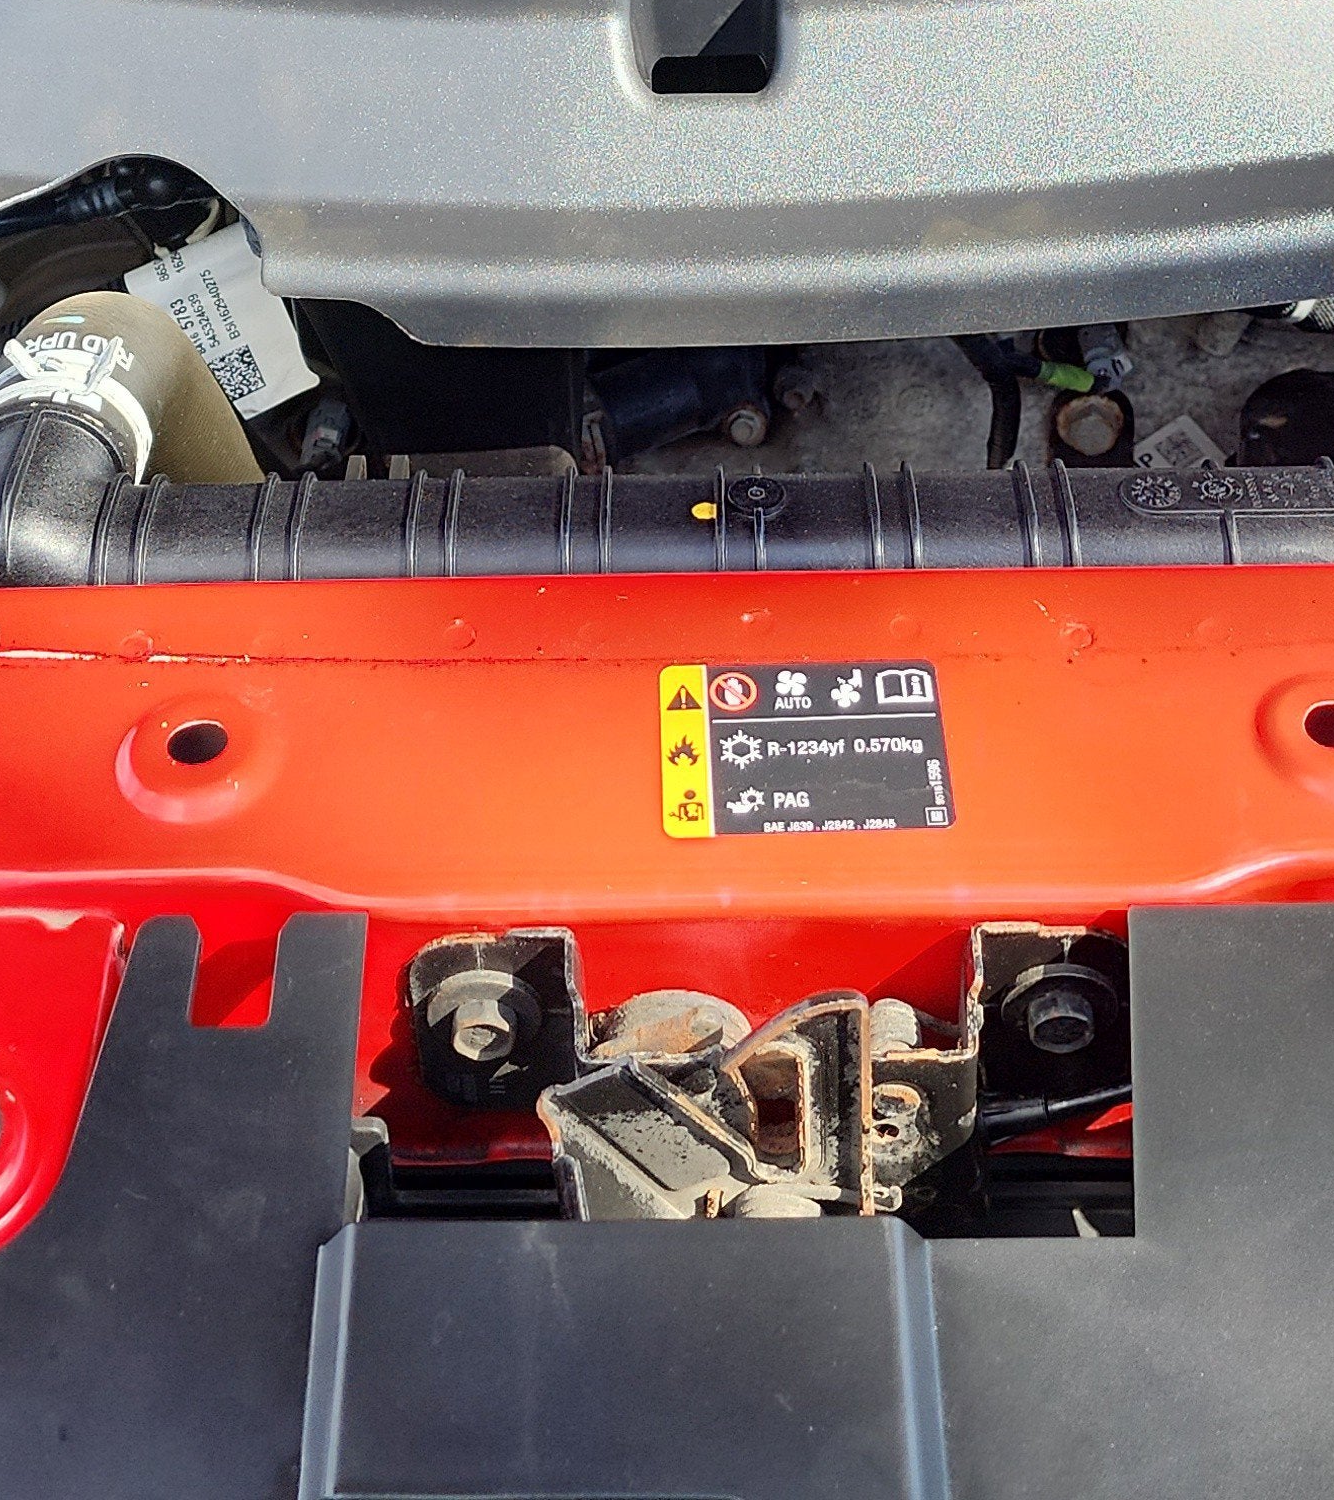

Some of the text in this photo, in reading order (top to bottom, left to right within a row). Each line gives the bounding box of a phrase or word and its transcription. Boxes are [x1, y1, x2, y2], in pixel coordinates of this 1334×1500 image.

[153, 258, 170, 282] 865
[170, 298, 195, 330] 5783
[187, 293, 220, 348] 545324639
[25, 331, 77, 354] UPR
[774, 696, 812, 710] AUTO
[767, 736, 924, 757] R-1234yf 0.570kg
[772, 791, 810, 809] PAG
